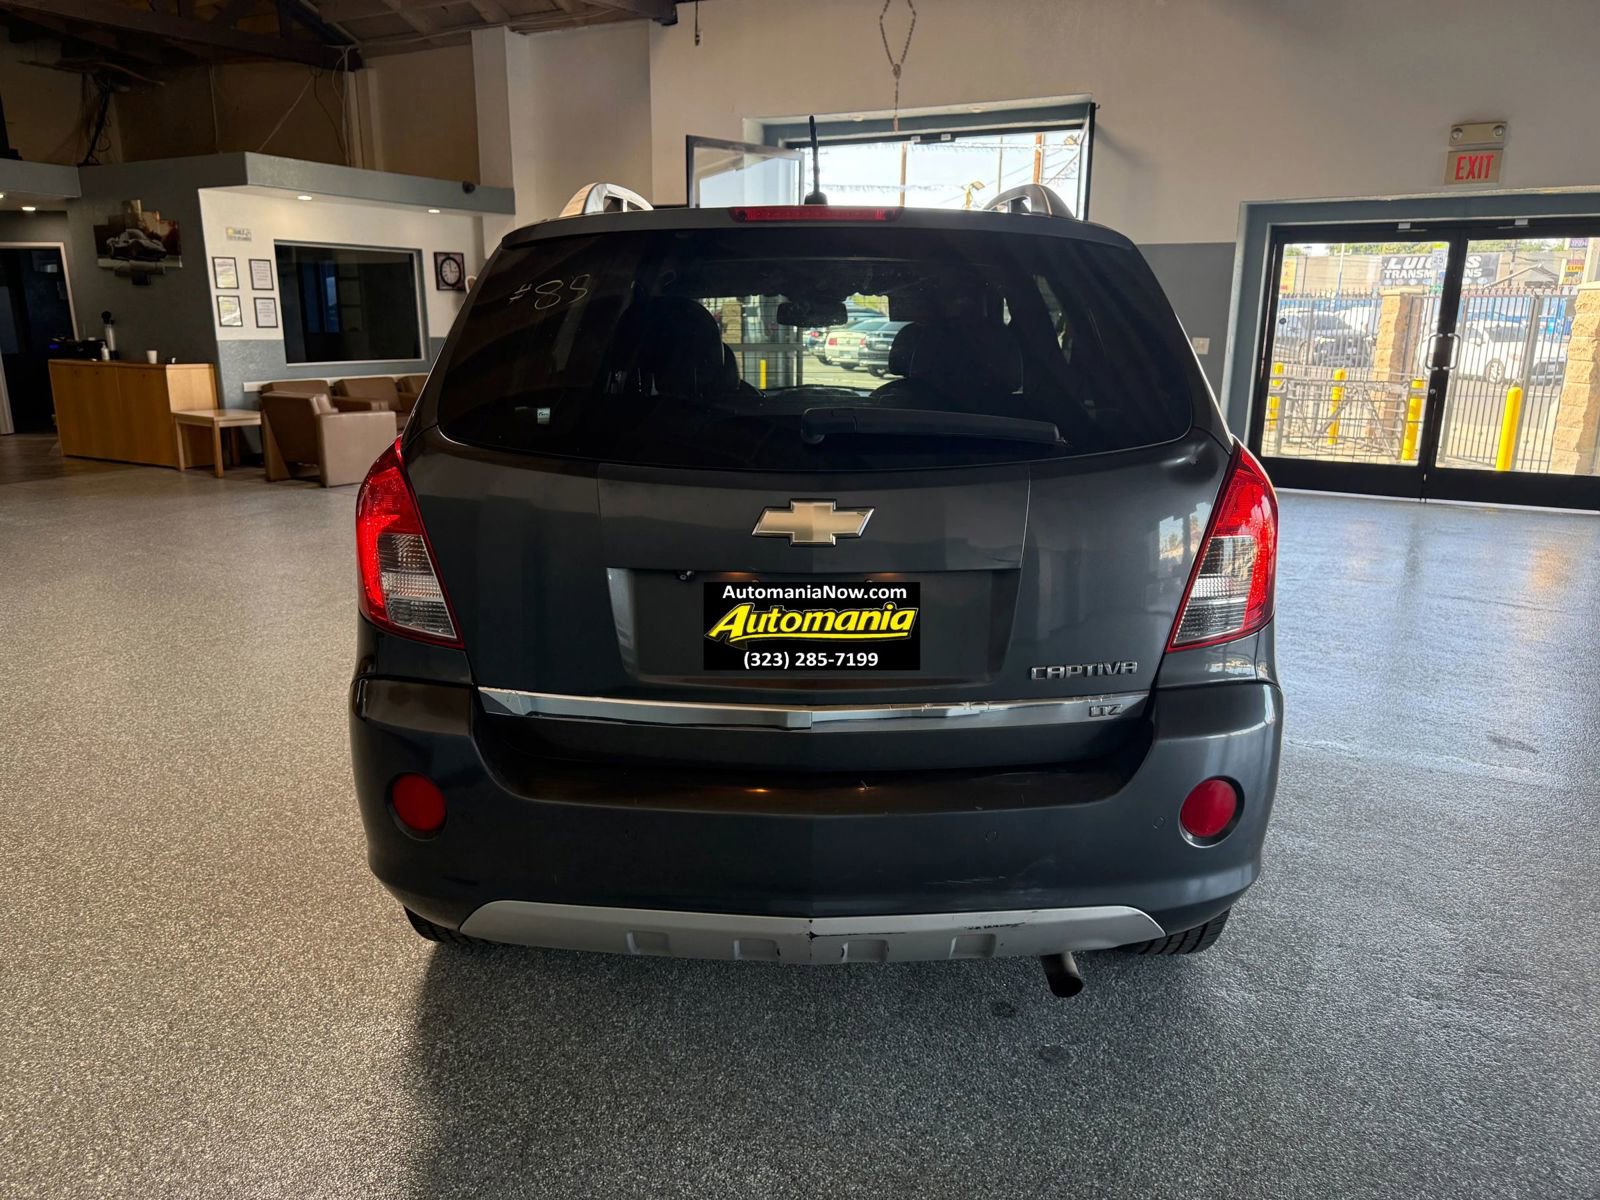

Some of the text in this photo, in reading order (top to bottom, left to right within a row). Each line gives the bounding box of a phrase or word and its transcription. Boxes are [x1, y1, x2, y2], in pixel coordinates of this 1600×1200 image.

[1455, 154, 1494, 180] EXIT
[1030, 661, 1138, 680] CAPTIVA
[1090, 704, 1122, 717] LTZ
